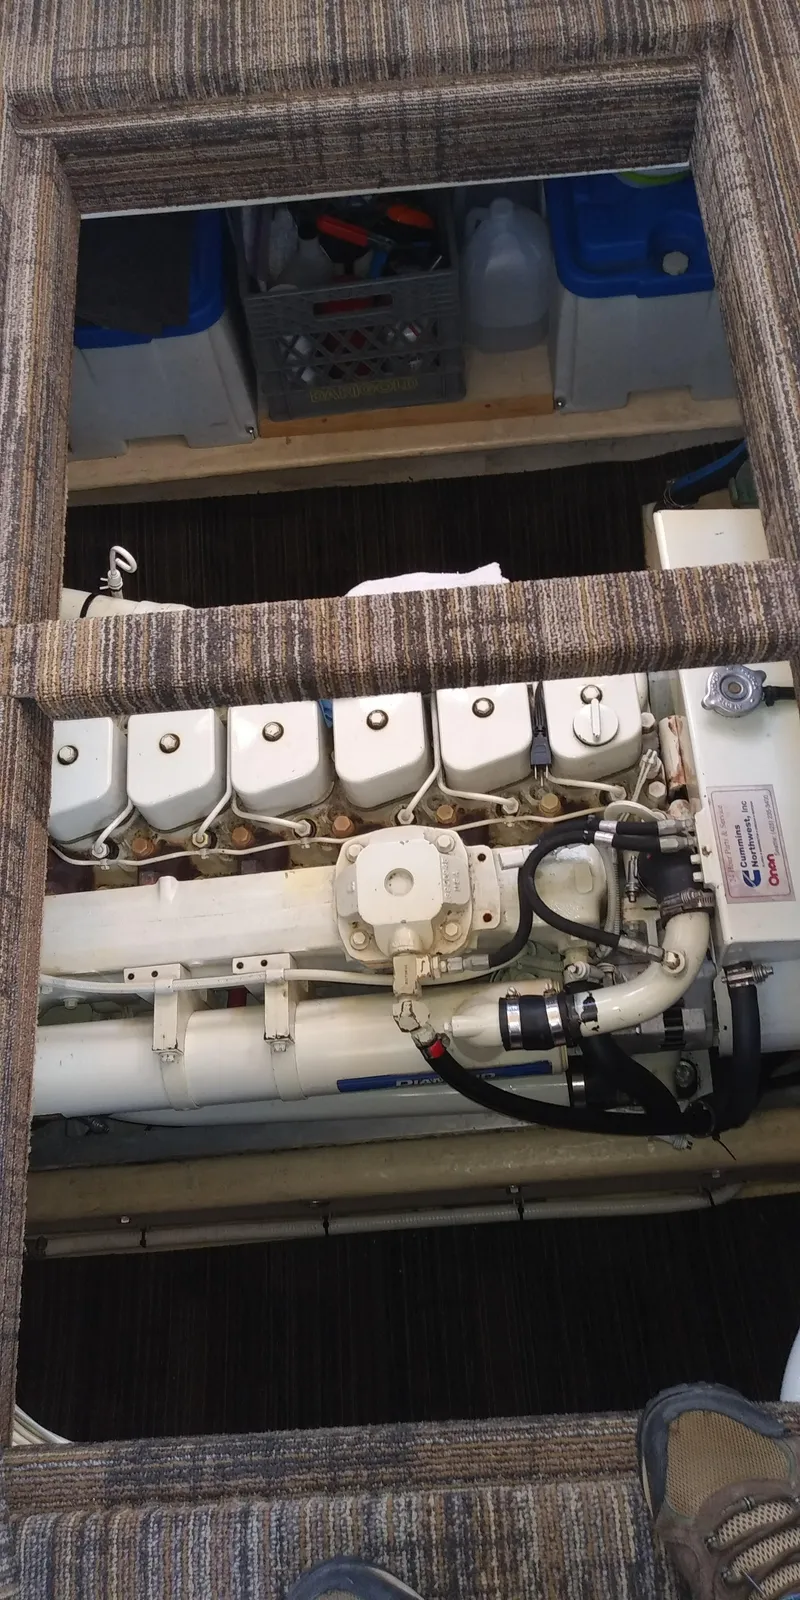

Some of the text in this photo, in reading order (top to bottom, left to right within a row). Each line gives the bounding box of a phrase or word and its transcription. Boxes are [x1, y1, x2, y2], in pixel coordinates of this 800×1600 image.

[741, 800, 749, 813] Inc
[735, 824, 748, 868] Cummins
[744, 815, 760, 868] Northwest,
[766, 853, 780, 887] Onan
